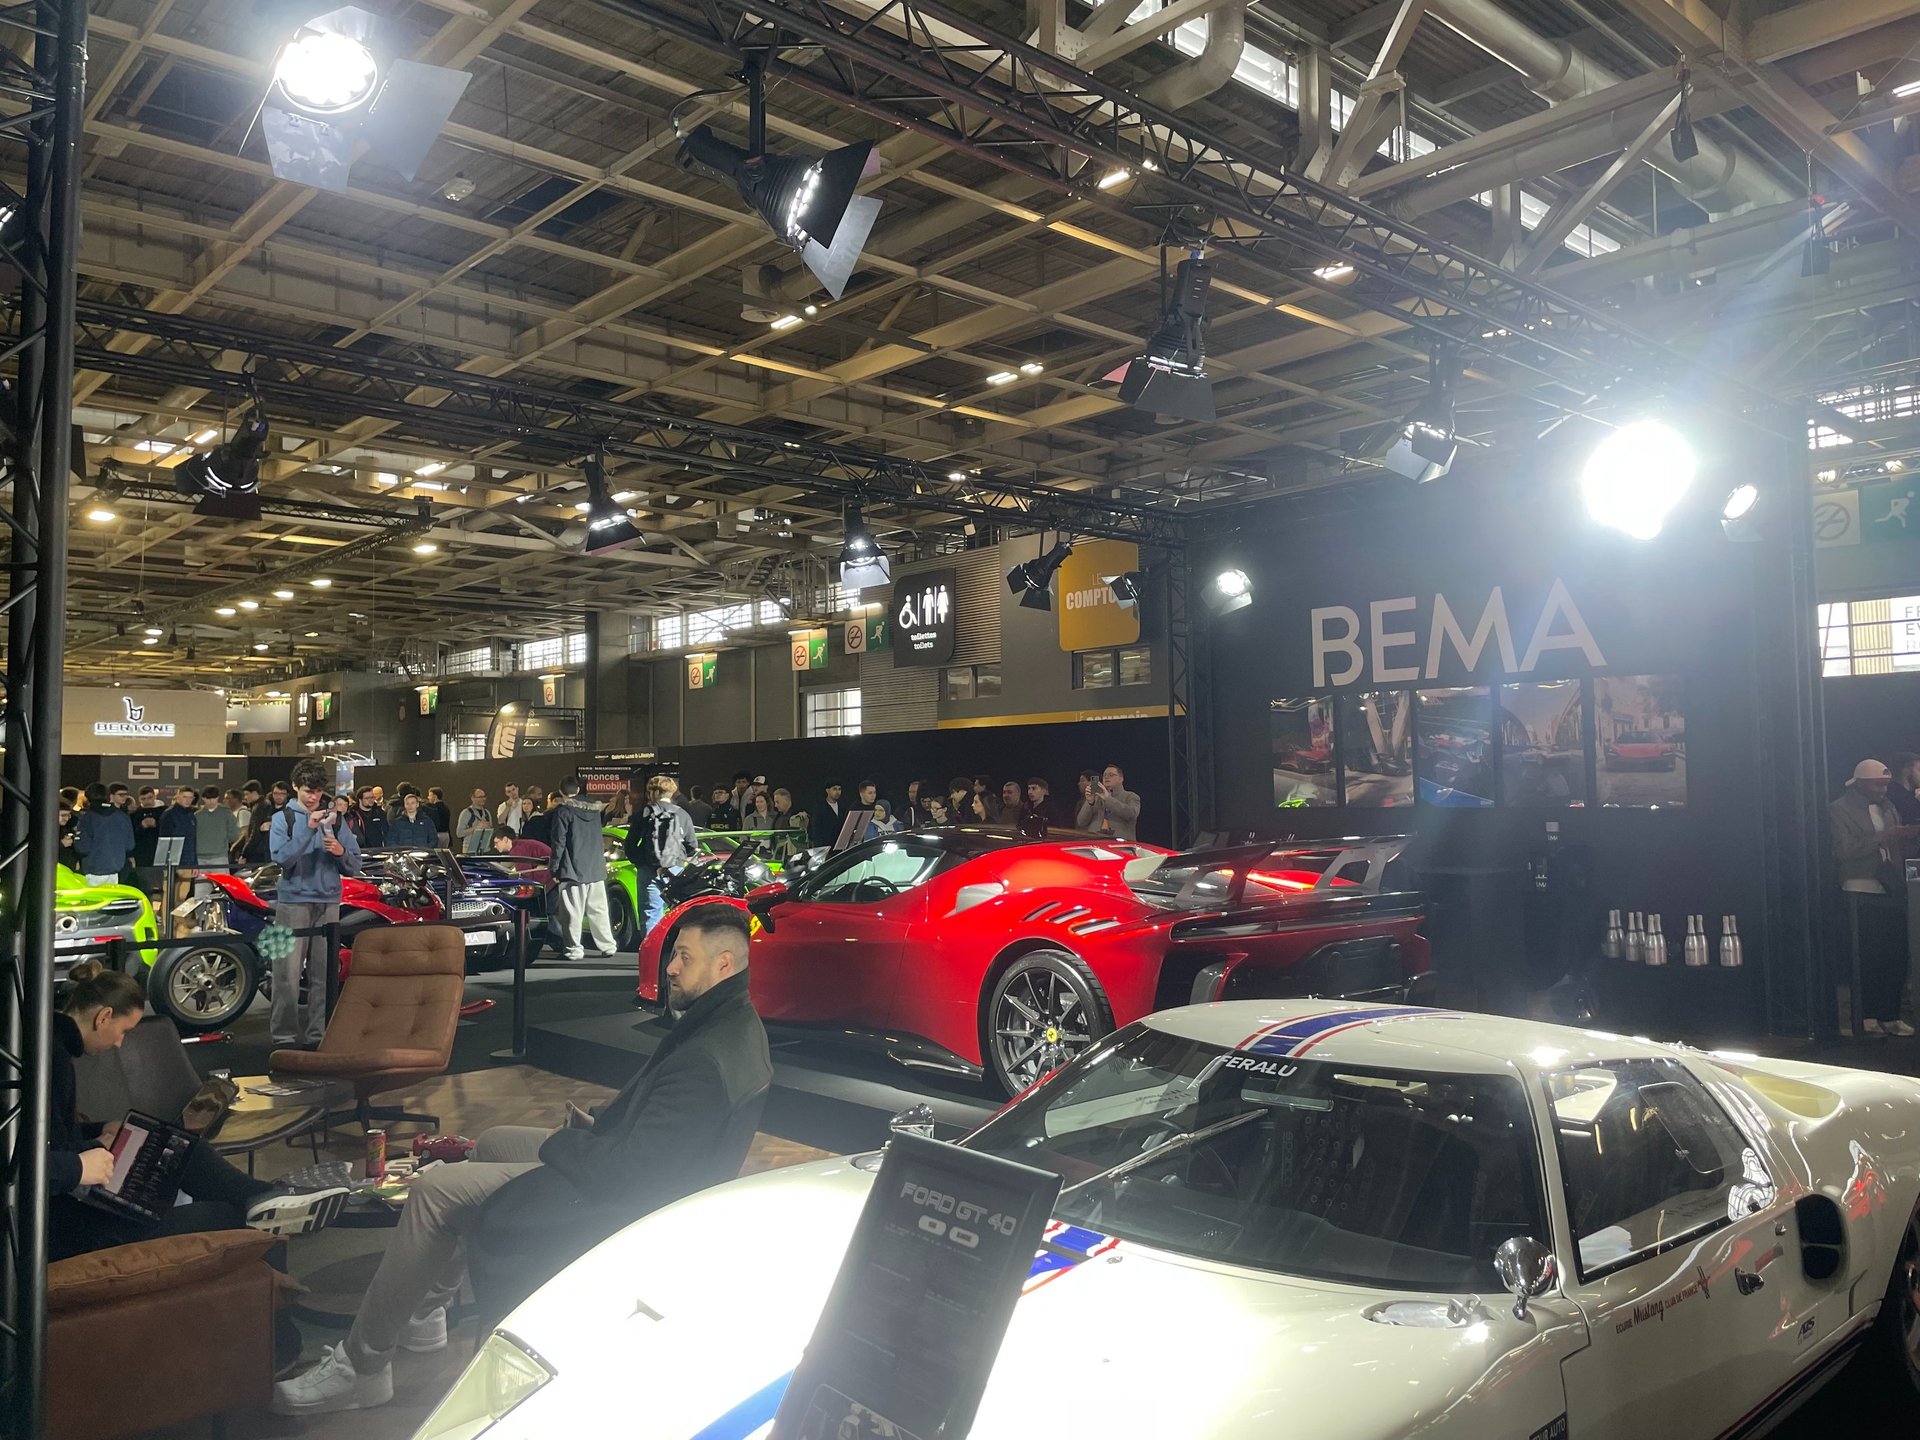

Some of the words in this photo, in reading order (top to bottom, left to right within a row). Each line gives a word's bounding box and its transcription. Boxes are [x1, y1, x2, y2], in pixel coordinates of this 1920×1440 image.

[1065, 586, 1116, 611] COMPTO
[910, 631, 937, 641] toilettes
[1310, 577, 1608, 688] BEMA
[913, 641, 934, 650] toilets
[95, 723, 174, 732] BERTONE
[127, 761, 224, 780] GTH
[578, 772, 620, 781] nonces
[586, 782, 627, 791] tomobile
[1220, 1055, 1298, 1077] FERALU
[900, 1181, 956, 1215] FORD
[955, 1201, 989, 1224] GT
[987, 1213, 1017, 1237] 40
[1633, 1300, 1664, 1324] Mustang
[1682, 1286, 1699, 1300] FRANCE
